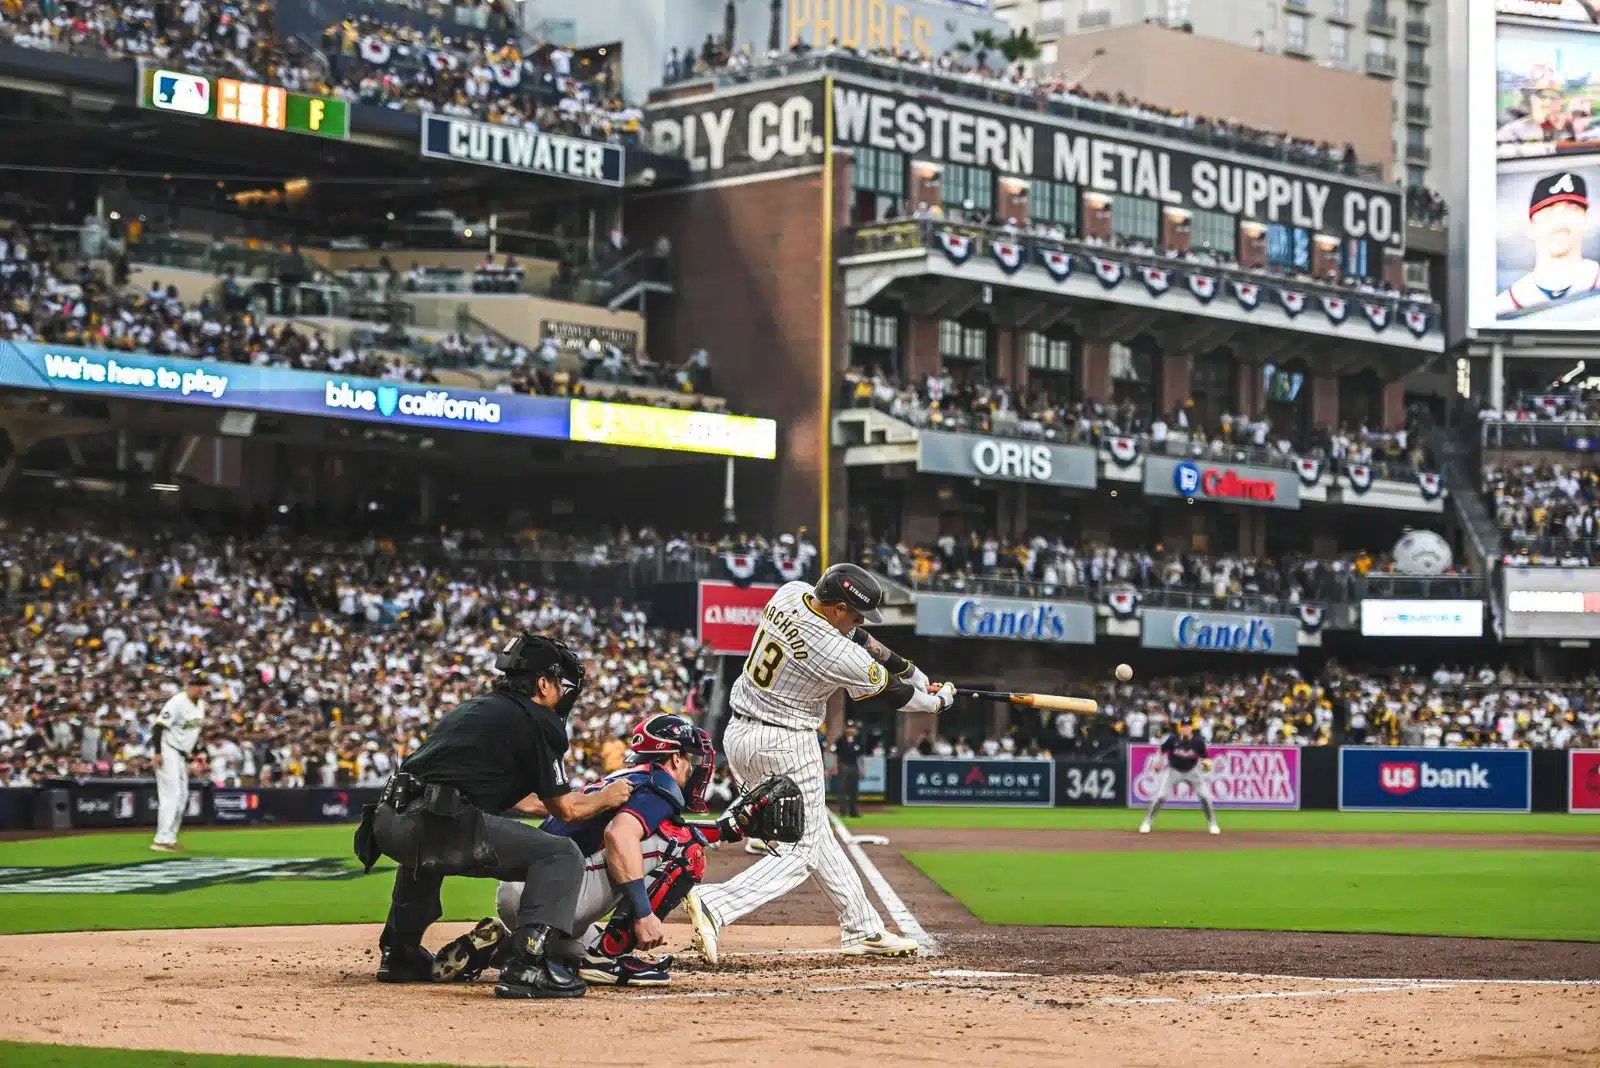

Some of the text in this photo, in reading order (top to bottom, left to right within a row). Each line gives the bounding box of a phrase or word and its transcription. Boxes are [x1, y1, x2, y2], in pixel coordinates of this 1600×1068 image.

[308, 98, 325, 131] F
[749, 94, 824, 162] CO.
[449, 119, 605, 181] CUTWATER
[832, 87, 1401, 244] WESTERN METAL SUPPLY CO.
[44, 353, 229, 399] We're here to play
[325, 380, 501, 423] blue california
[971, 440, 1053, 480] ORIS
[848, 584, 871, 604] STRAUSS
[954, 599, 1066, 640] Canel's
[1176, 613, 1274, 652] Canel's
[746, 629, 785, 690] 13
[1066, 767, 1117, 800] 342
[1228, 751, 1288, 778] BAJA
[1381, 761, 1489, 788] us bank
[1136, 776, 1292, 802] CLIORNIA
